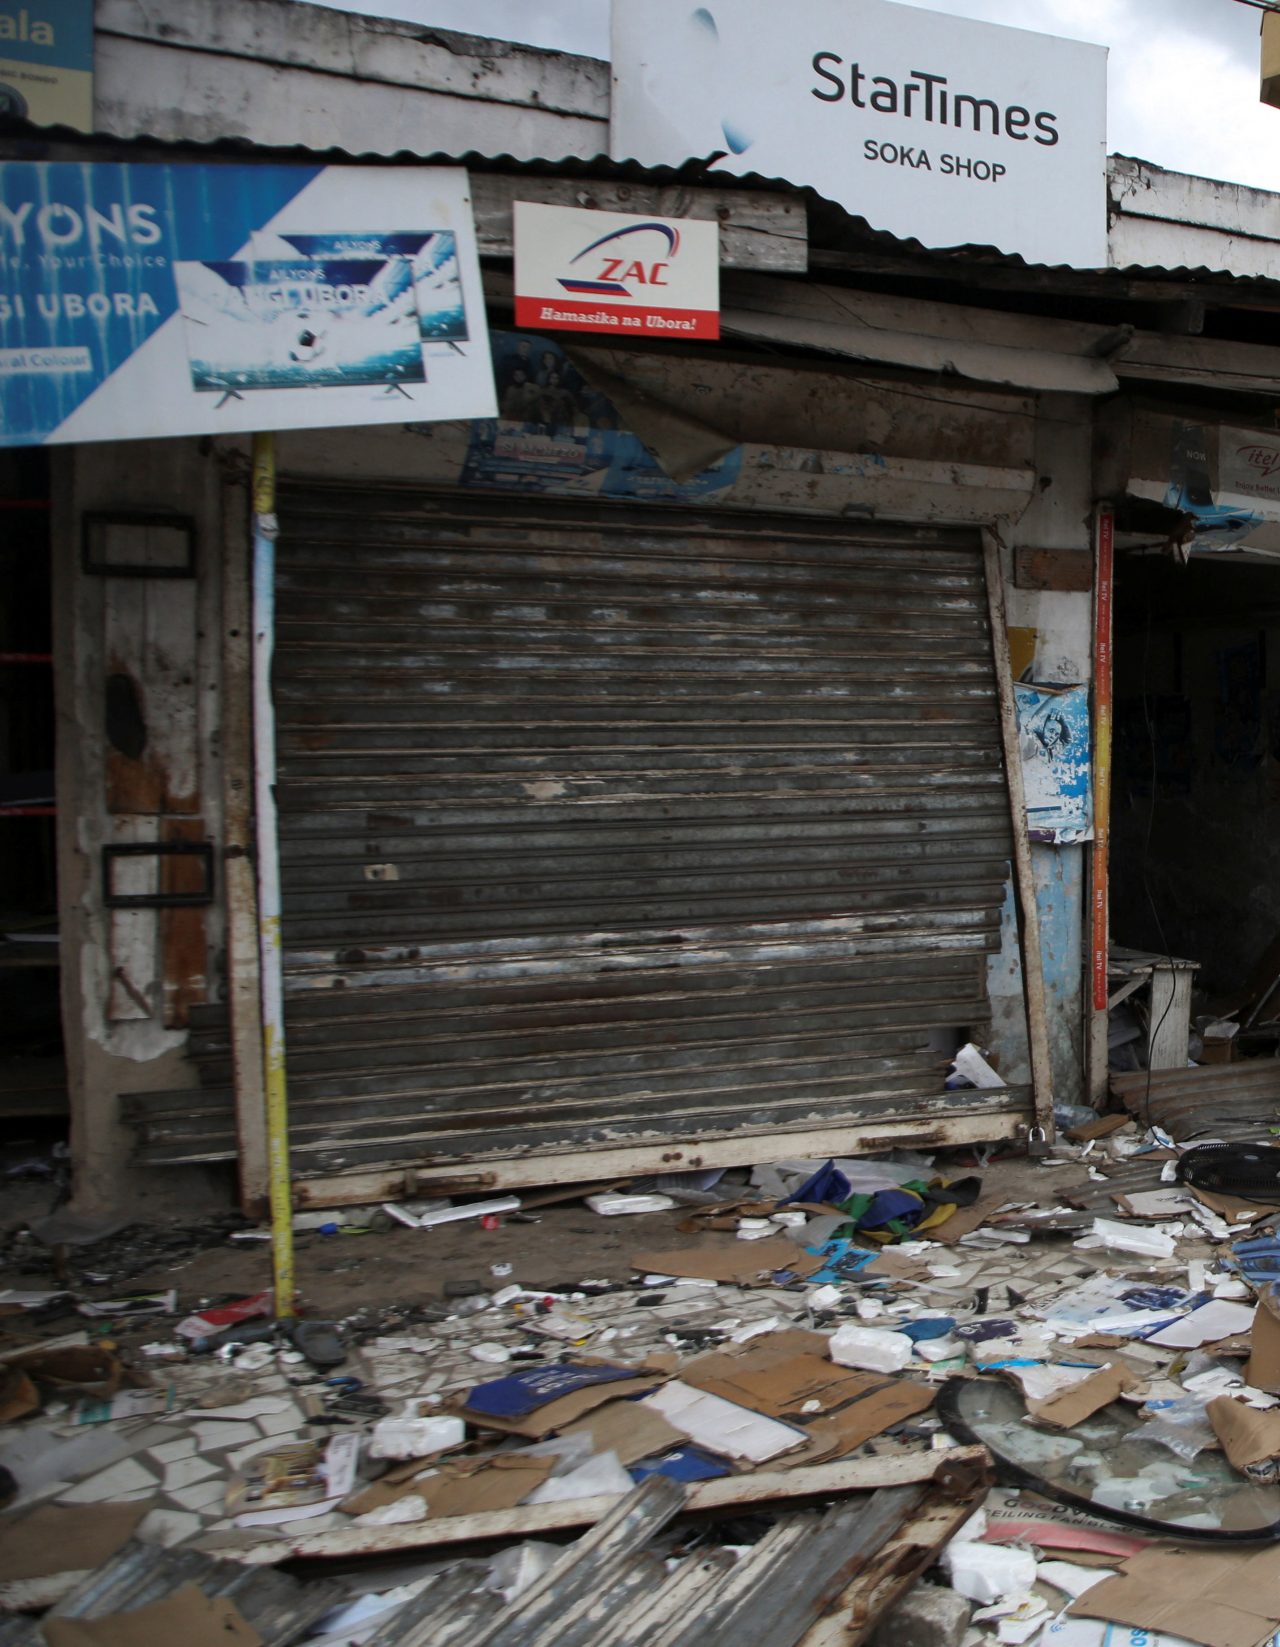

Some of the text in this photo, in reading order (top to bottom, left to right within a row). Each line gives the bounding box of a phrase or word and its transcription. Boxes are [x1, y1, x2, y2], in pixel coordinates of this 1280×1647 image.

[811, 51, 1059, 146] StarTimes
[863, 139, 1007, 183] SOKA SHOP
[597, 258, 670, 286] ZAC
[37, 292, 160, 318] UBORA
[540, 307, 698, 331] Hamasika na Ubora!
[1247, 450, 1279, 465] itel
[1049, 1513, 1084, 1526] FAN
